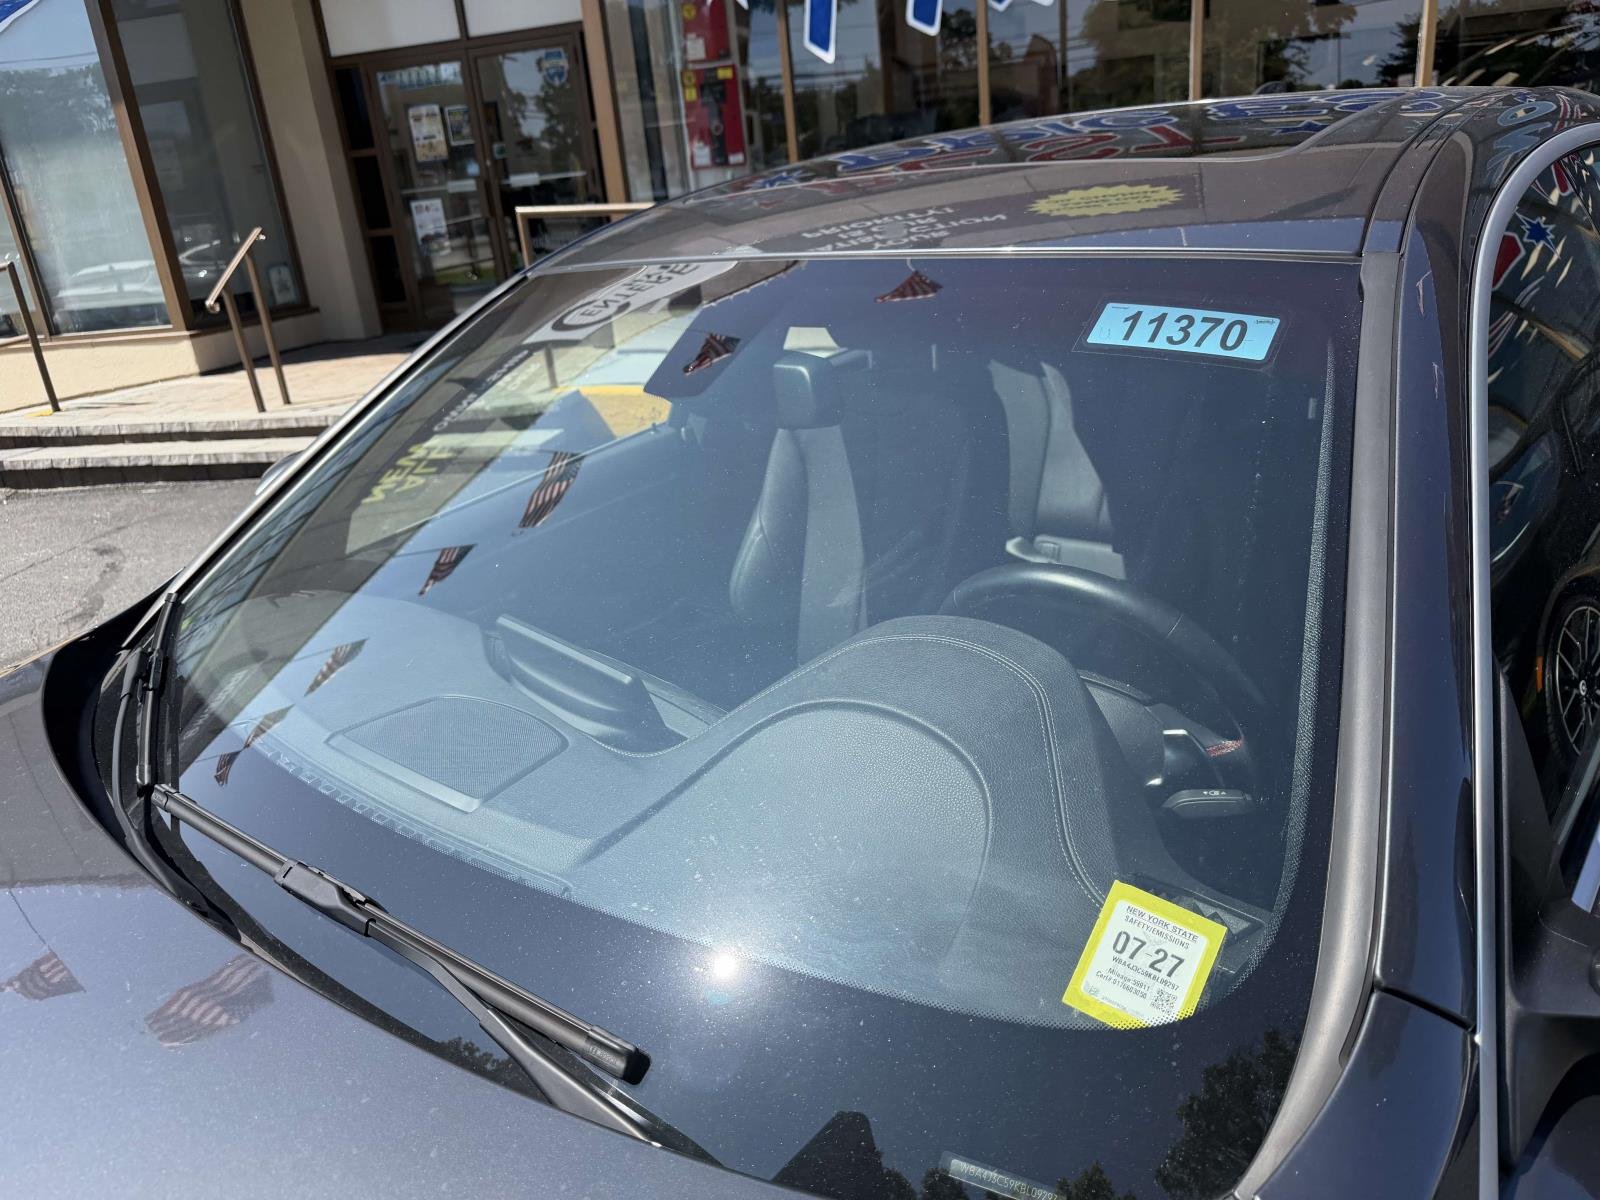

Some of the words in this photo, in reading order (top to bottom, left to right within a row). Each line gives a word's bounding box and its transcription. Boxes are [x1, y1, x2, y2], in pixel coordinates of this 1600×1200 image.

[1123, 311, 1248, 351] 11370
[1124, 915, 1190, 949] SAFETY/EMISSIONS
[1126, 905, 1145, 920] NEW
[1146, 912, 1171, 929] YORK
[1171, 924, 1199, 942] STATE
